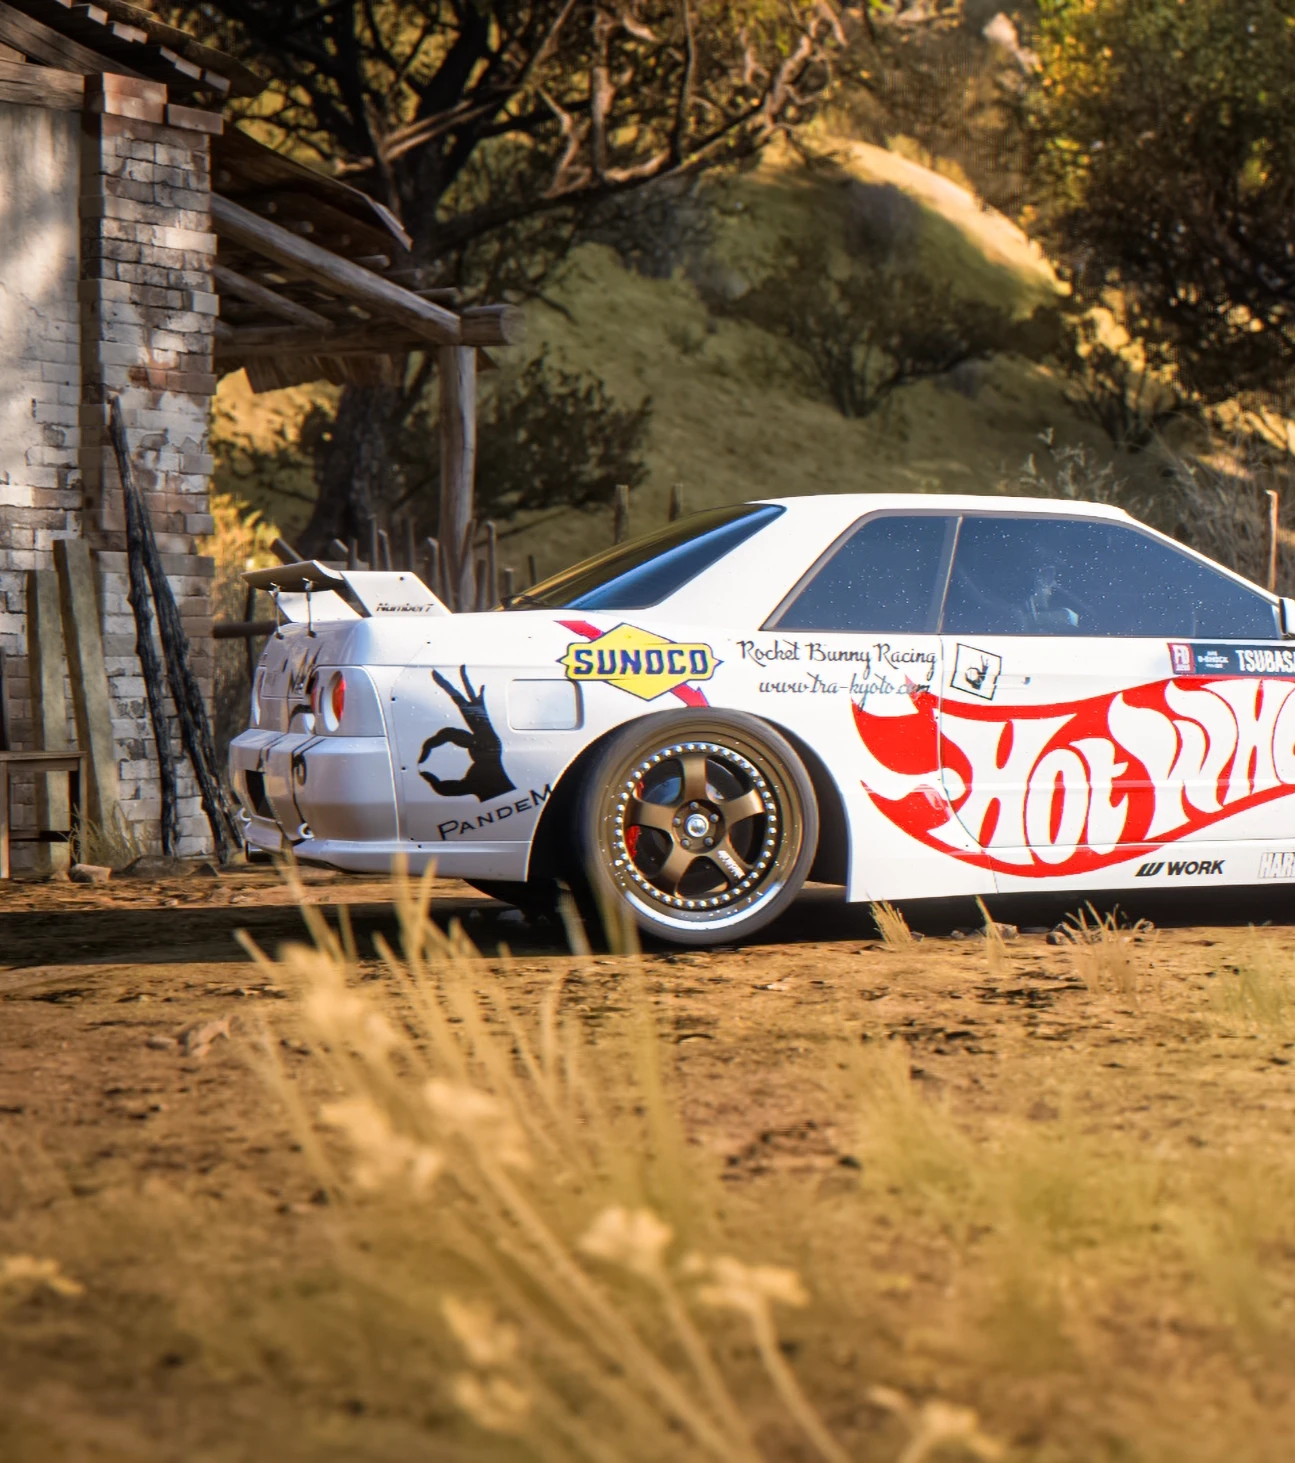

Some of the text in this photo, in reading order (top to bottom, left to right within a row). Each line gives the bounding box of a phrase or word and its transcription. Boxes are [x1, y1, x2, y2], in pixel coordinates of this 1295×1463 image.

[573, 649, 710, 675] SUNOCO
[736, 639, 936, 681] Rocket Bunny Racing
[1168, 859, 1226, 877] WORK
